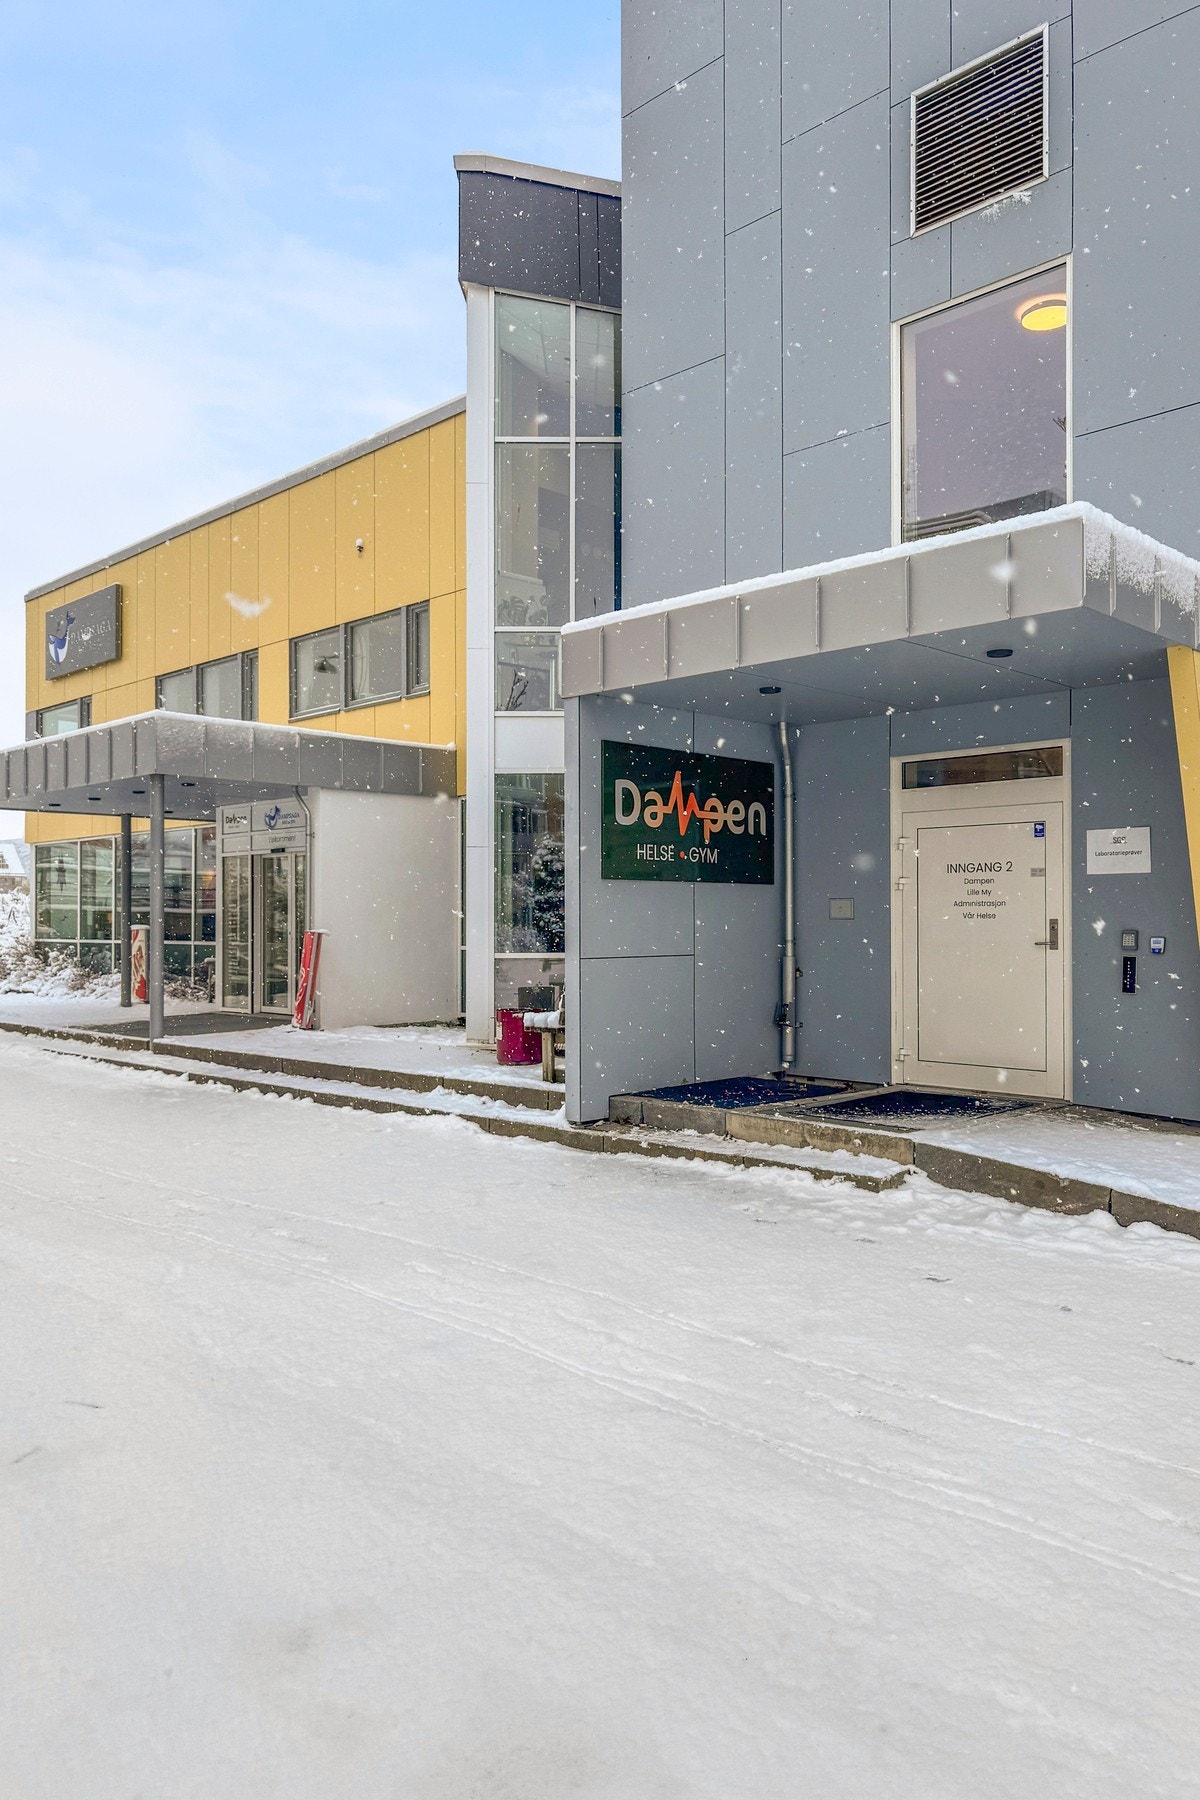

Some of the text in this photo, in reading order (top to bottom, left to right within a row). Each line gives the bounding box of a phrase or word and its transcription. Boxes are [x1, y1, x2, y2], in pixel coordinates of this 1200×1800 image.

[637, 844, 718, 864] HELSE GYM
[946, 860, 1013, 874] INNGANG 2
[963, 878, 995, 886] Dampen
[981, 889, 992, 897] My
[953, 900, 1007, 908] Administrasjon
[962, 911, 975, 919] Vår
